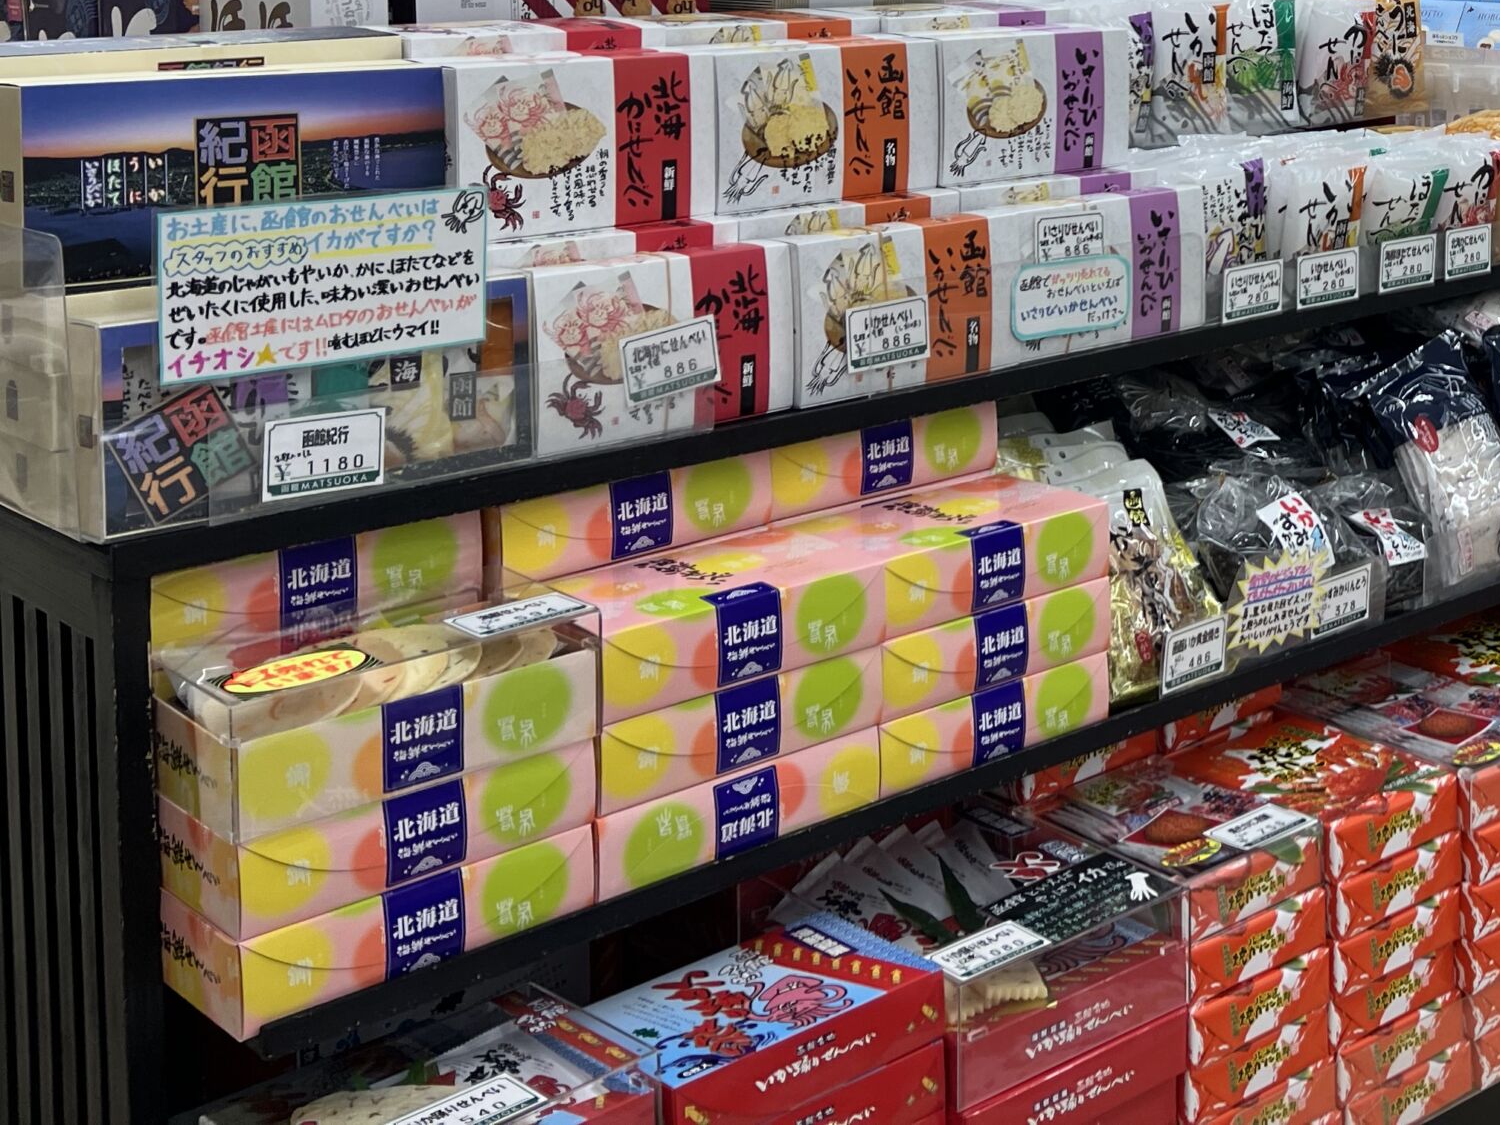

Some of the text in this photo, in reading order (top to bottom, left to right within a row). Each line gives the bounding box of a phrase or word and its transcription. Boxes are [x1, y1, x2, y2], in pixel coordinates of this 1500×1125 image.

[1404, 3, 1416, 37] 北海
[877, 53, 908, 120] 函館
[650, 70, 689, 141] 北海
[885, 142, 898, 169] 名物
[106, 156, 121, 205] ほたて
[1042, 220, 1099, 237] いさりびせんべい
[1063, 243, 1091, 256] 886
[1463, 251, 1481, 263] 280
[1309, 258, 1348, 275] いかせんべい
[1402, 263, 1424, 276] 280
[1045, 277, 1124, 299] おせんべいといえば
[1247, 290, 1269, 304] 280
[1322, 278, 1345, 291] 280
[864, 310, 914, 330] いかせんべい
[1020, 294, 1118, 321] いさりびいかせんべい
[881, 333, 912, 350] 886
[663, 360, 697, 378] 886
[302, 427, 349, 447] 函館紀行
[866, 436, 910, 460] 北海道
[306, 454, 364, 472] 1180
[617, 492, 668, 521] 北海道
[287, 559, 352, 590] 北海道
[977, 548, 1022, 577] 北海道
[723, 616, 778, 646] 北海道
[981, 627, 1025, 657] 北海道
[389, 708, 459, 745] 北海道
[723, 698, 777, 732] 北海道
[977, 702, 1023, 733] 北海道
[394, 801, 461, 845] 北海道
[391, 897, 460, 941] 北海道
